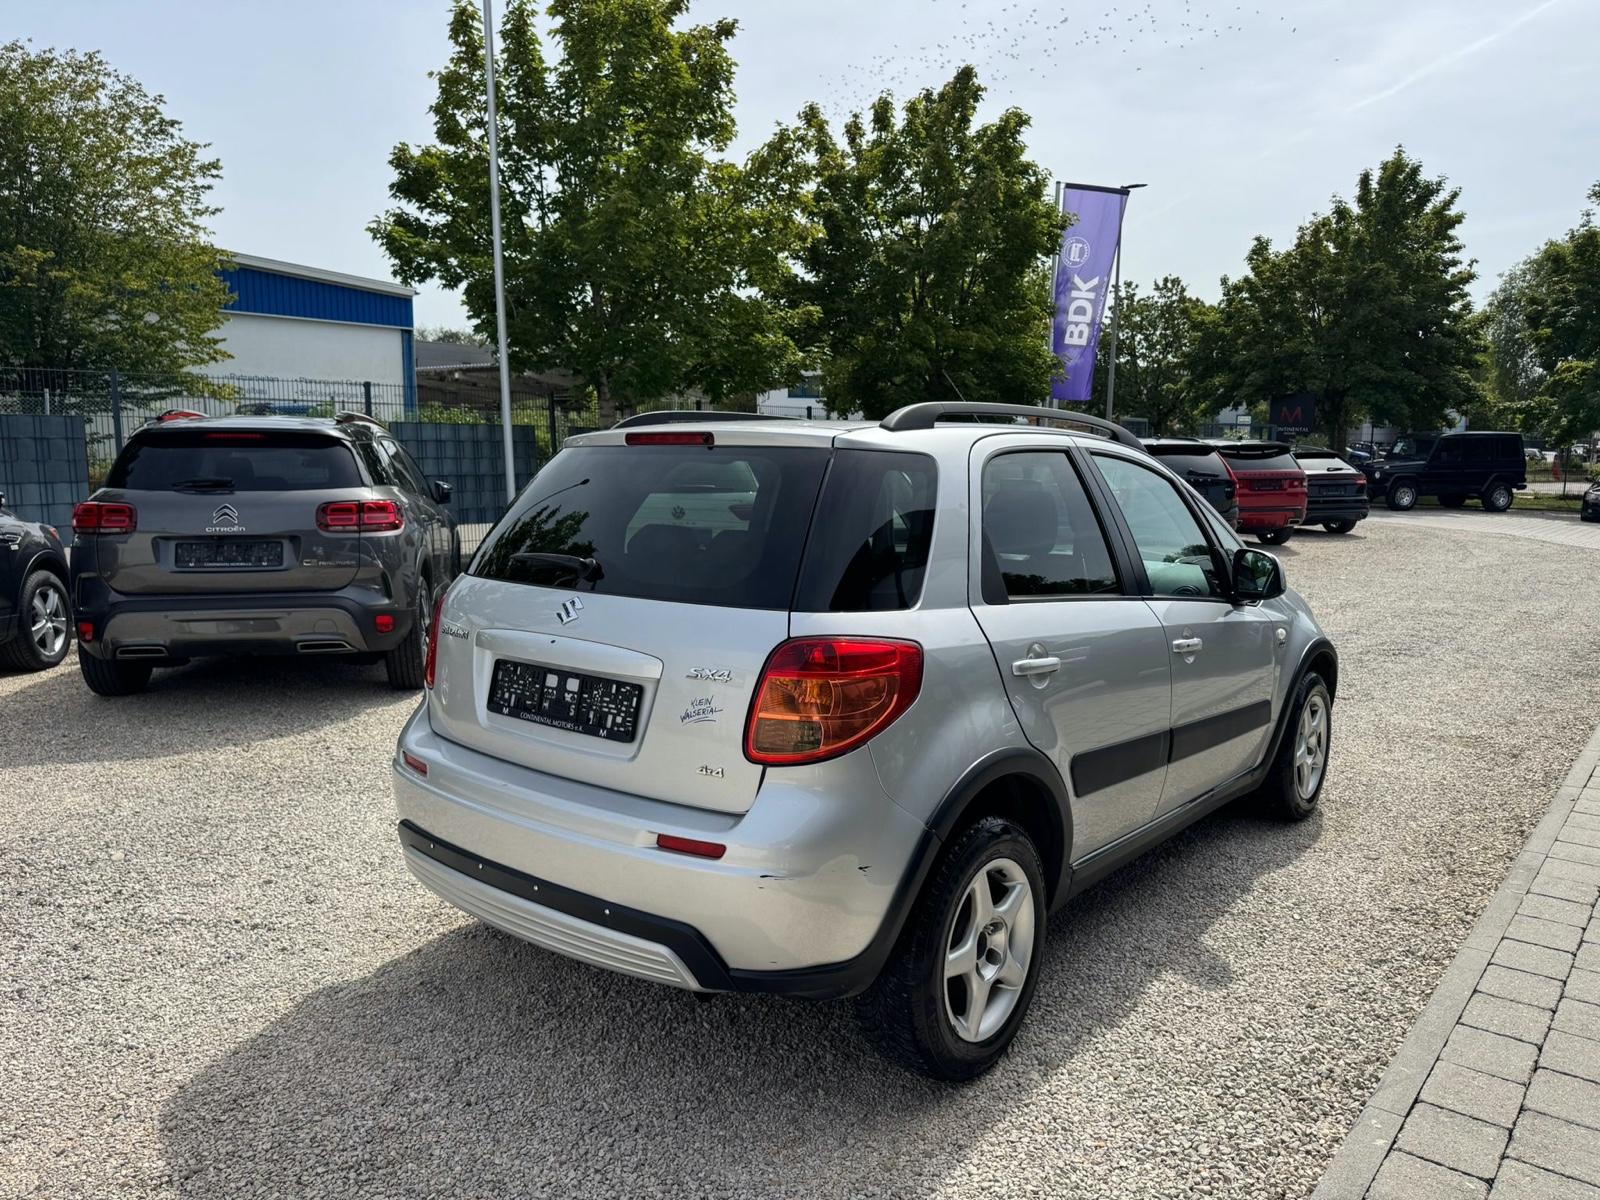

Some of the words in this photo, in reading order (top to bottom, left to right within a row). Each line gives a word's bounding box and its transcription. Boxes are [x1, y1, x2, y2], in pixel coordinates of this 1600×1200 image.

[1064, 274, 1100, 346] BDK
[686, 667, 733, 683] SX4
[690, 695, 714, 709] KLEIN
[520, 711, 552, 725] CONTINENTAL
[552, 719, 575, 729] MOTORS
[680, 706, 724, 723] WALSERTAL
[696, 765, 725, 778] 4x4
